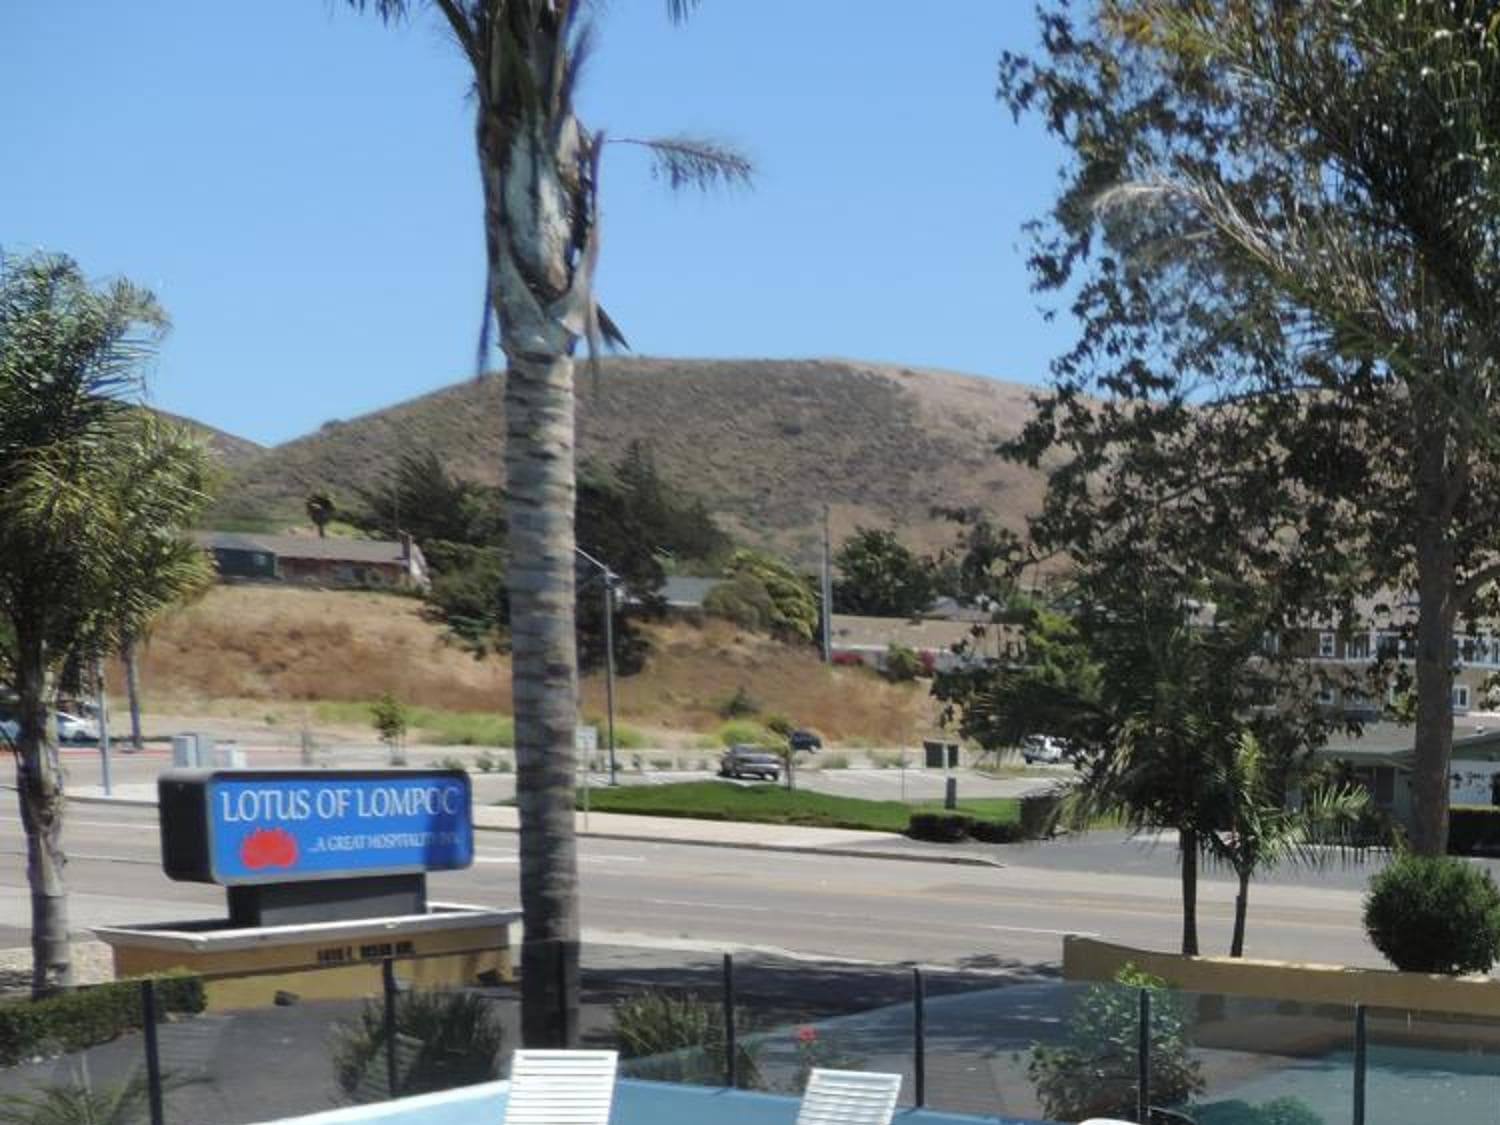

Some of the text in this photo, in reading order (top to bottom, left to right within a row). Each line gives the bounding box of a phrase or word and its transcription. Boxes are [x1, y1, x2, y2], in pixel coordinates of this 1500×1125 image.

[219, 786, 460, 821] LOTUS OF LOMPOC
